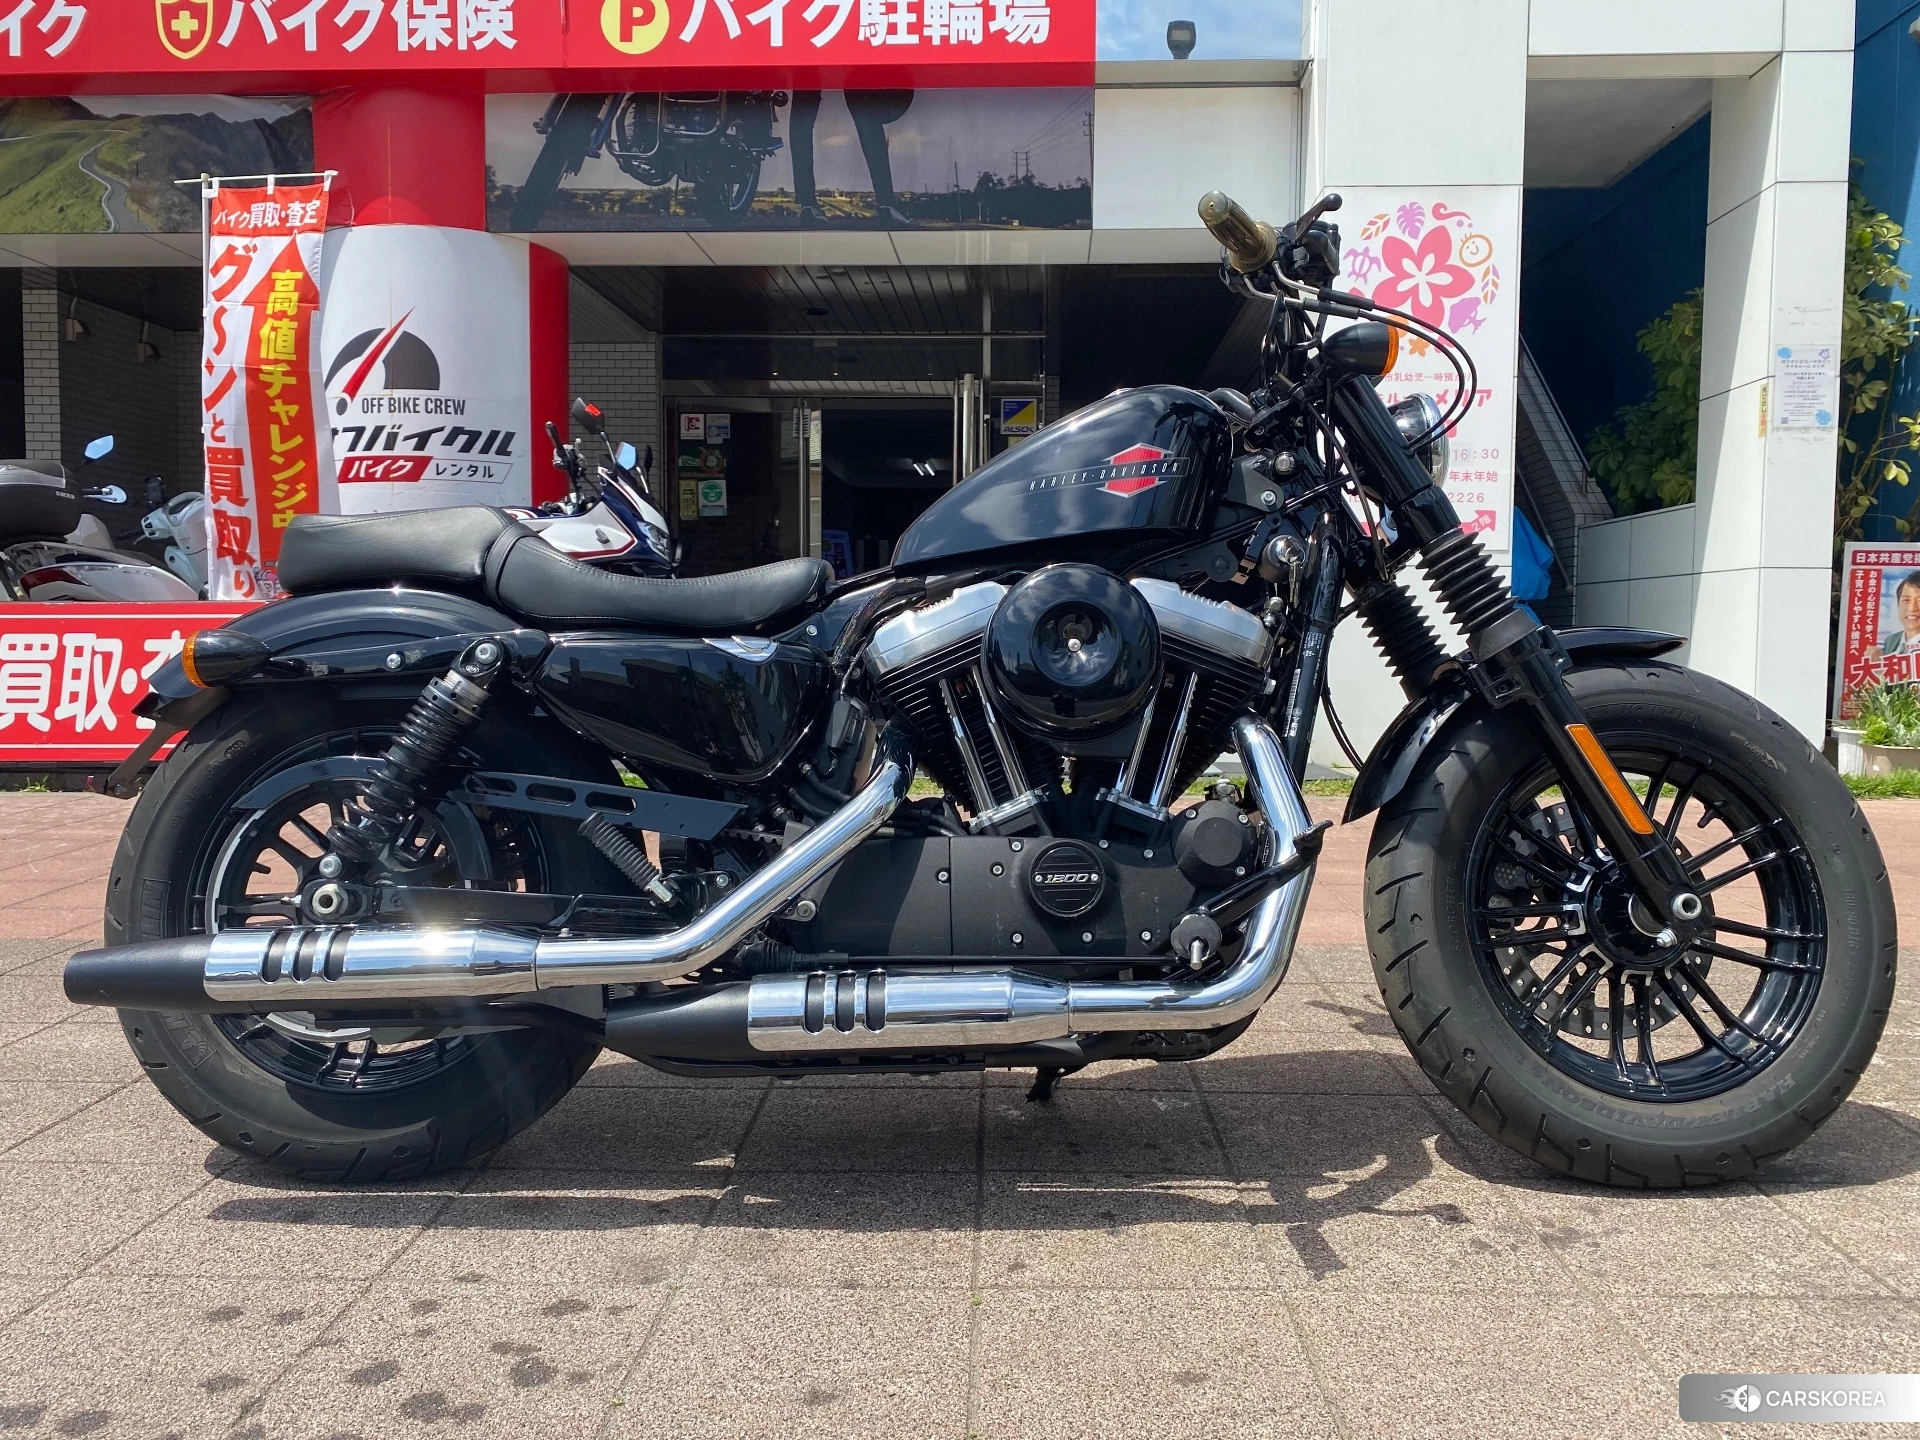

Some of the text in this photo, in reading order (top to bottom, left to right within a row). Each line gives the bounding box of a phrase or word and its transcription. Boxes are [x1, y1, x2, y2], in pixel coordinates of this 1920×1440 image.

[217, 0, 518, 52] バイク保険
[678, 0, 1051, 48] バイク駐輪場
[213, 199, 321, 229] バイク買取・査定
[361, 397, 466, 416] OFF BIKE CREW
[1002, 425, 1035, 433] ALSOK
[1453, 448, 1500, 461] 16:30
[348, 459, 494, 479] バイク レンタル
[1029, 461, 1178, 491] HARLEY-DAVIDSON
[1448, 470, 1499, 483] 年末年始
[1044, 873, 1090, 884] 1200
